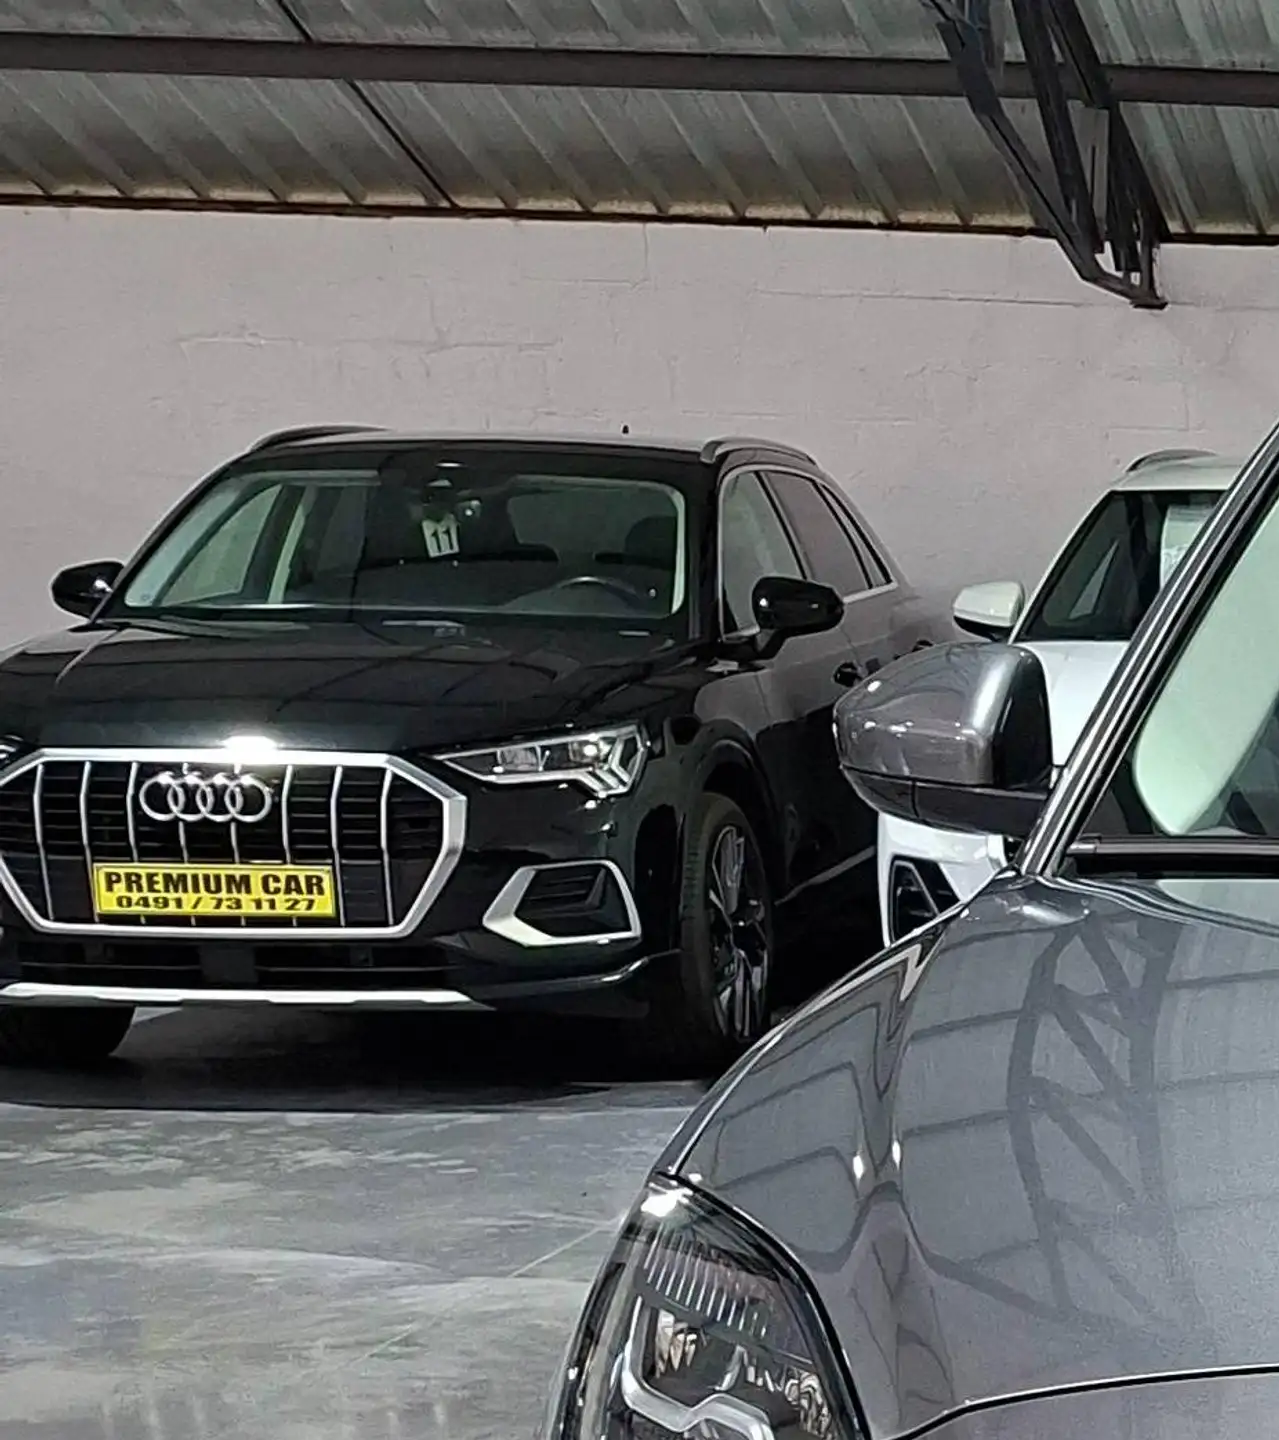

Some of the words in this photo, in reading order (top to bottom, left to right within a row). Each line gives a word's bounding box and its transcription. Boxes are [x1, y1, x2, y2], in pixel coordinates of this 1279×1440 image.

[431, 527, 454, 553] 11
[104, 871, 252, 895] PREMIUM
[261, 874, 325, 896] CAR
[116, 895, 183, 909] 0491
[191, 897, 203, 910] /
[211, 897, 243, 910] 73
[251, 898, 277, 910] 11
[285, 898, 316, 911] 27
